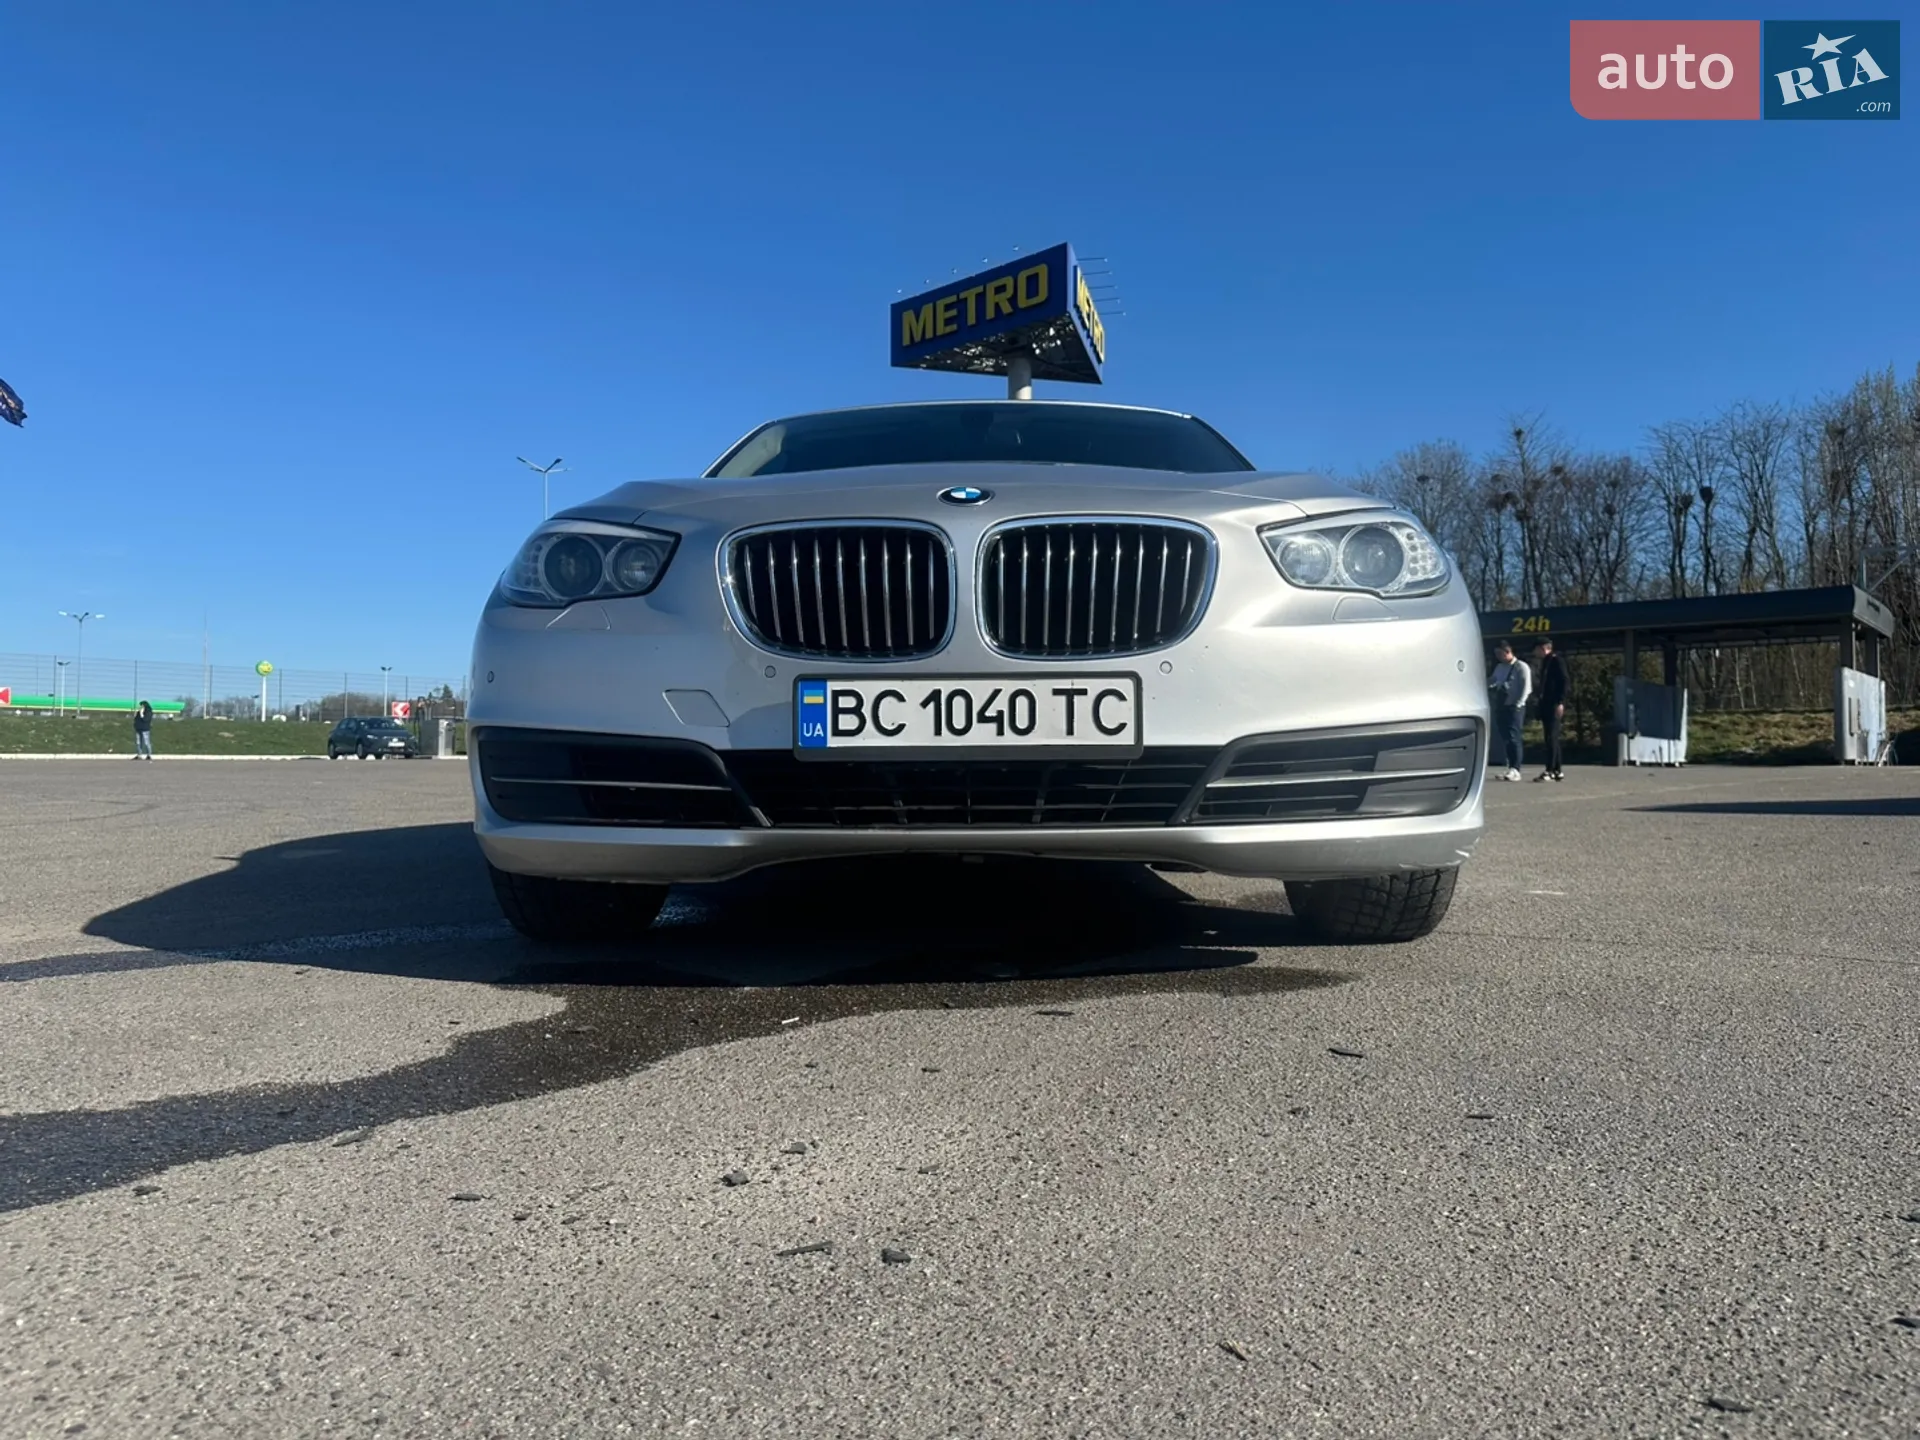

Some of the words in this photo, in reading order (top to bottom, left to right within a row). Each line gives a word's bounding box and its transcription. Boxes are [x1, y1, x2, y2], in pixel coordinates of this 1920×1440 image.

[901, 263, 1049, 347] METRO
[1511, 615, 1551, 633] 24h
[803, 722, 824, 738] UA
[831, 688, 907, 738] BC
[919, 688, 1037, 738] 1040
[1052, 688, 1128, 737] TC
